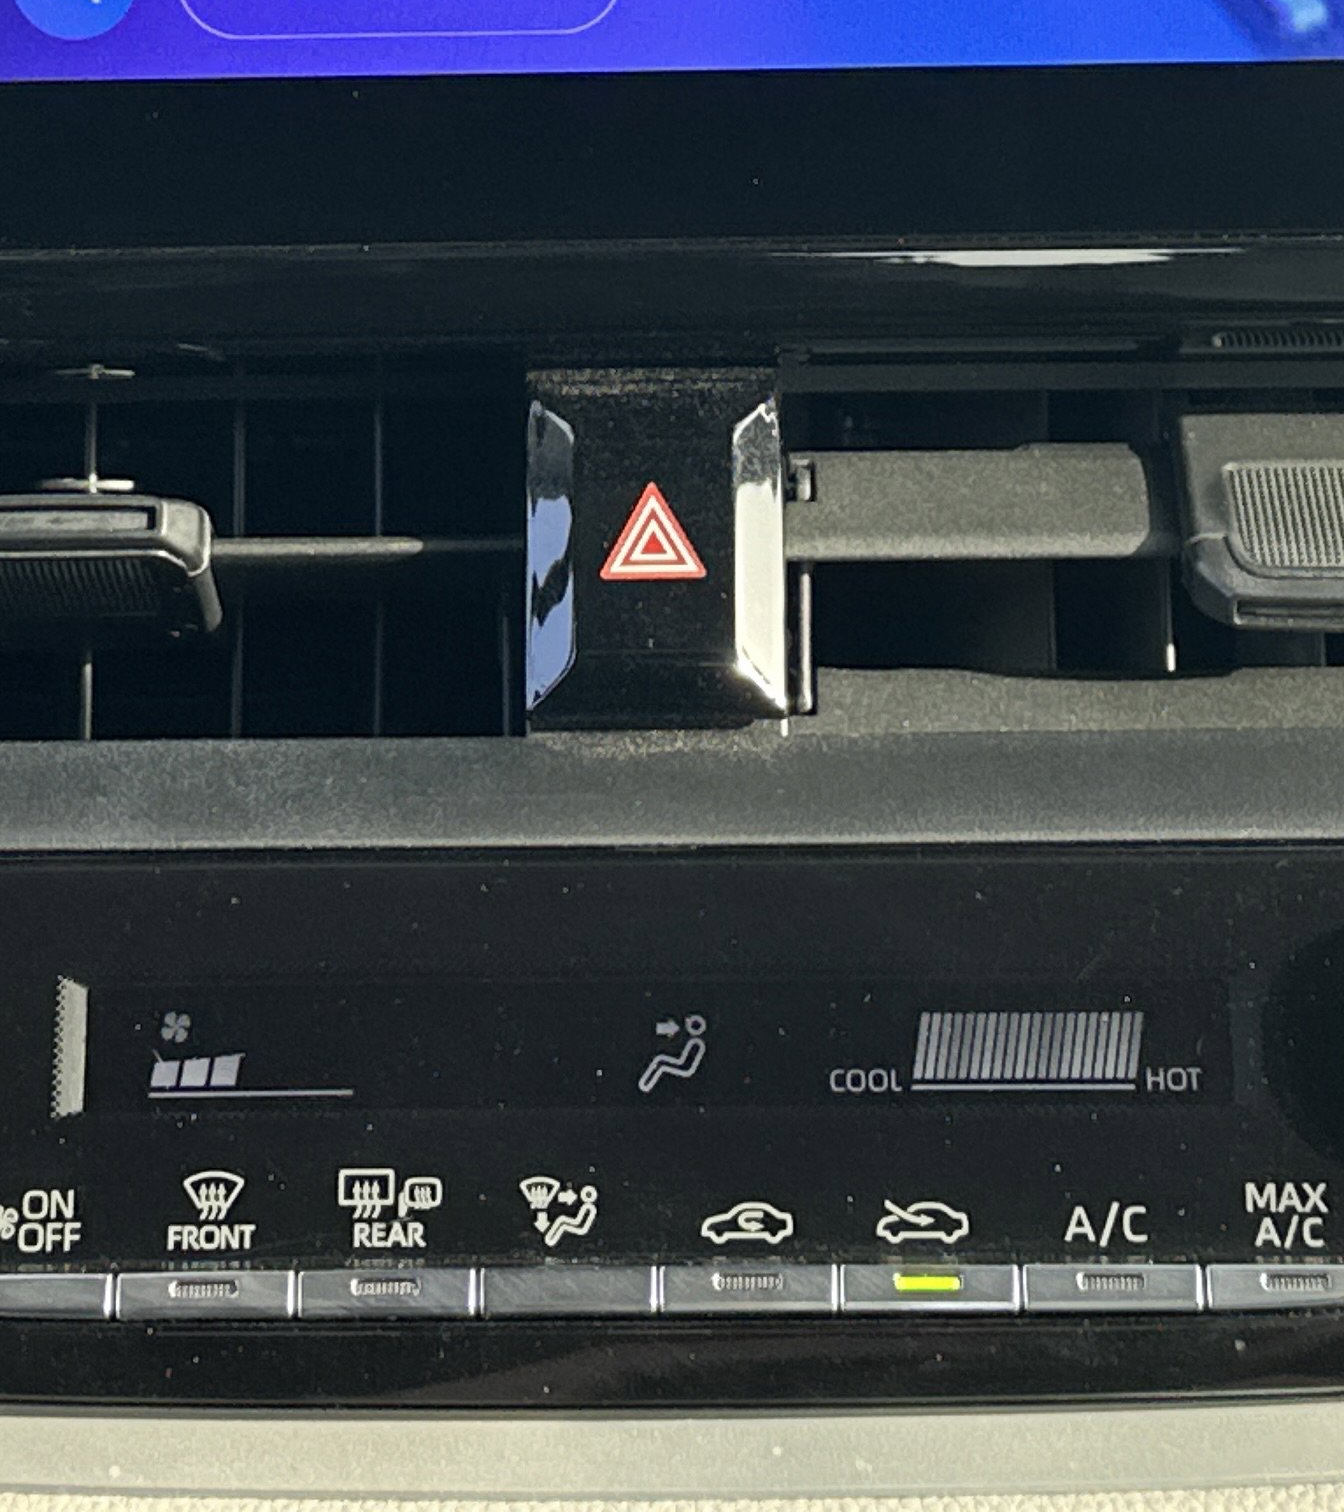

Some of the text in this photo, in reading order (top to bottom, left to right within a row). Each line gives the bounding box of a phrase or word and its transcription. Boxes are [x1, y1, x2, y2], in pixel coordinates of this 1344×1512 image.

[829, 1068, 903, 1093] COOL
[1146, 1067, 1202, 1091] HOT
[22, 1189, 75, 1221] ON
[1245, 1182, 1329, 1213] MAX
[17, 1221, 82, 1253] OFF
[167, 1224, 256, 1251] FRONT
[352, 1220, 427, 1249] REAR
[1064, 1201, 1149, 1247] A/C
[1255, 1215, 1325, 1250] A/C
